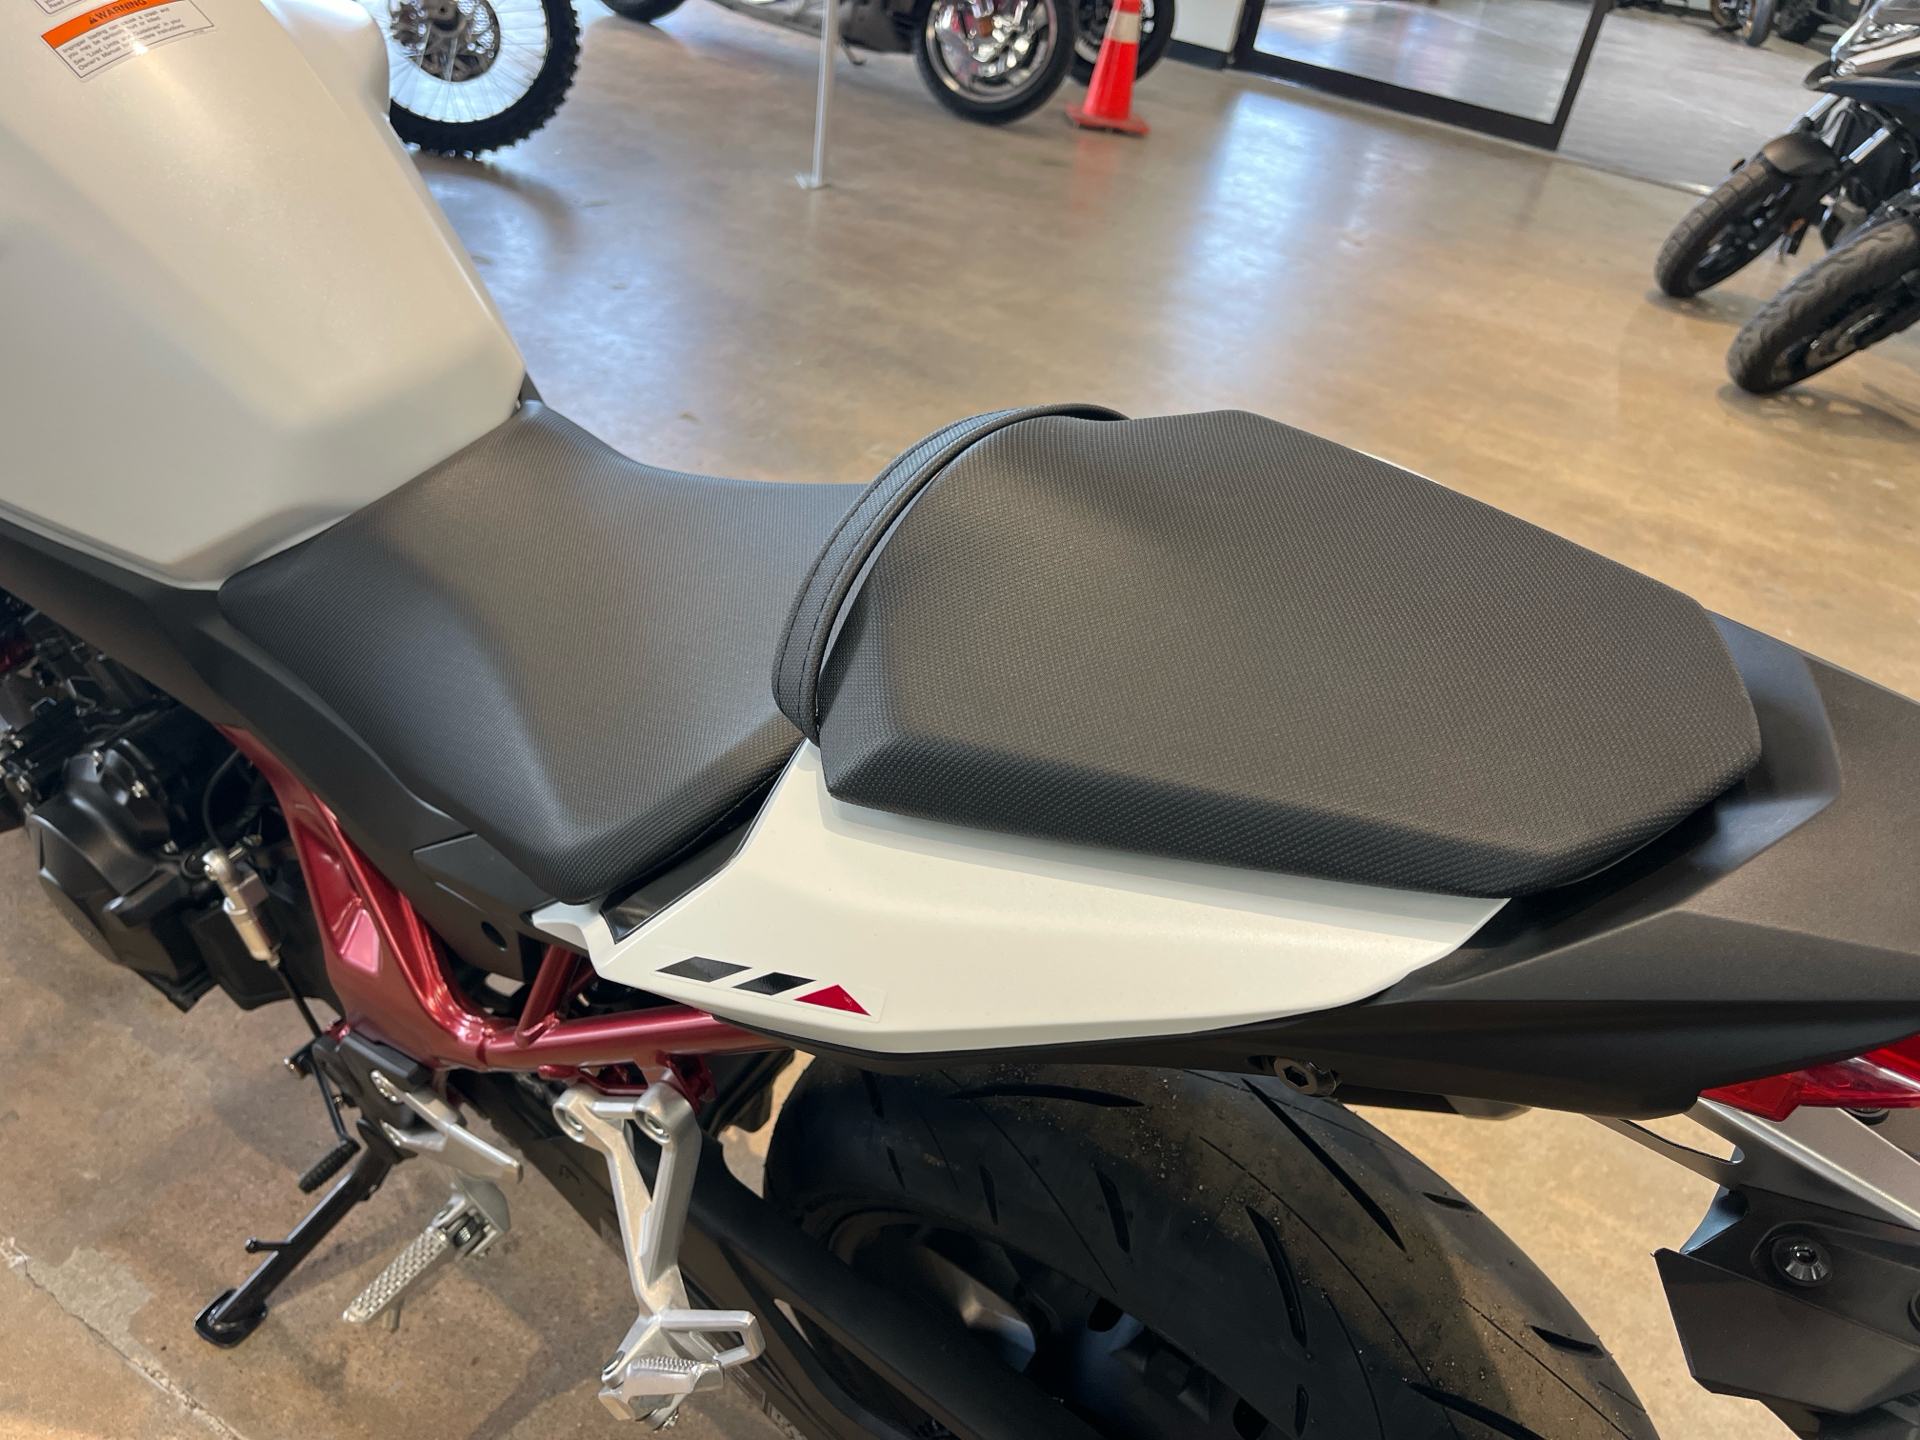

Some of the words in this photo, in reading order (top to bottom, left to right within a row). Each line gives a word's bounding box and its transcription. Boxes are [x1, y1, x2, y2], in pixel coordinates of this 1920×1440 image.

[95, 0, 147, 19] WARNING
[62, 40, 86, 53] Improper
[87, 29, 108, 40] loading
[121, 17, 137, 26] cause
[144, 10, 158, 18] crash
[67, 51, 79, 59] you
[79, 44, 91, 52] may
[102, 29, 125, 41] seriously
[73, 57, 85, 65] See
[103, 40, 120, 50] Limits
[78, 57, 101, 70] Owner's
[101, 46, 122, 58] Manual
